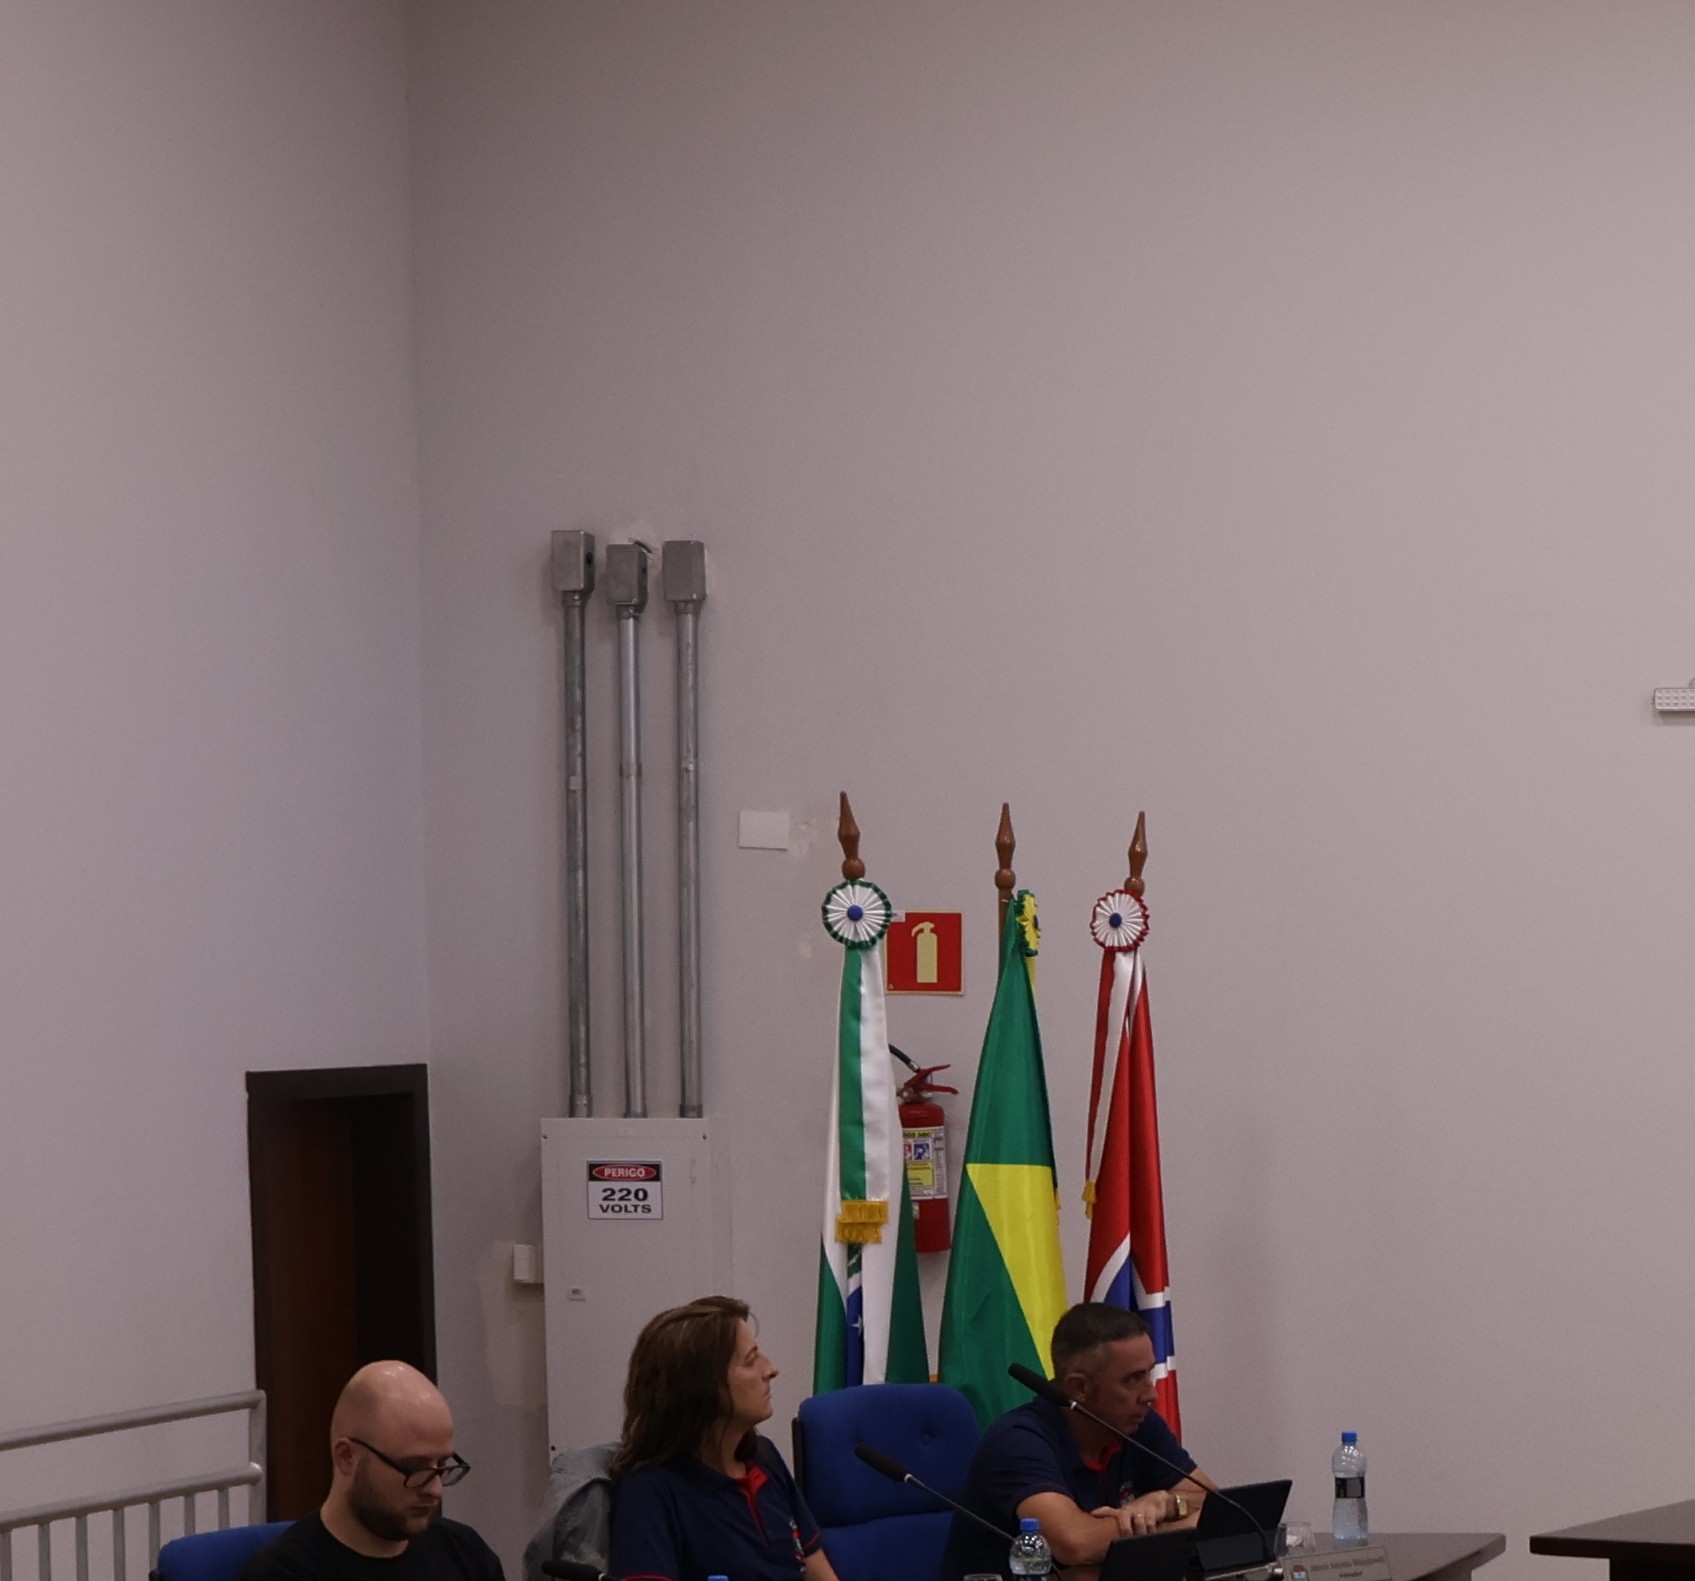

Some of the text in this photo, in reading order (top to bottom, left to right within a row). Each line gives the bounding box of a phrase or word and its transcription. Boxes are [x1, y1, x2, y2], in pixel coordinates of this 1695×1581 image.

[604, 1167, 645, 1178] PERIGO
[601, 1187, 649, 1202] 220
[598, 1203, 652, 1214] VOLTS
